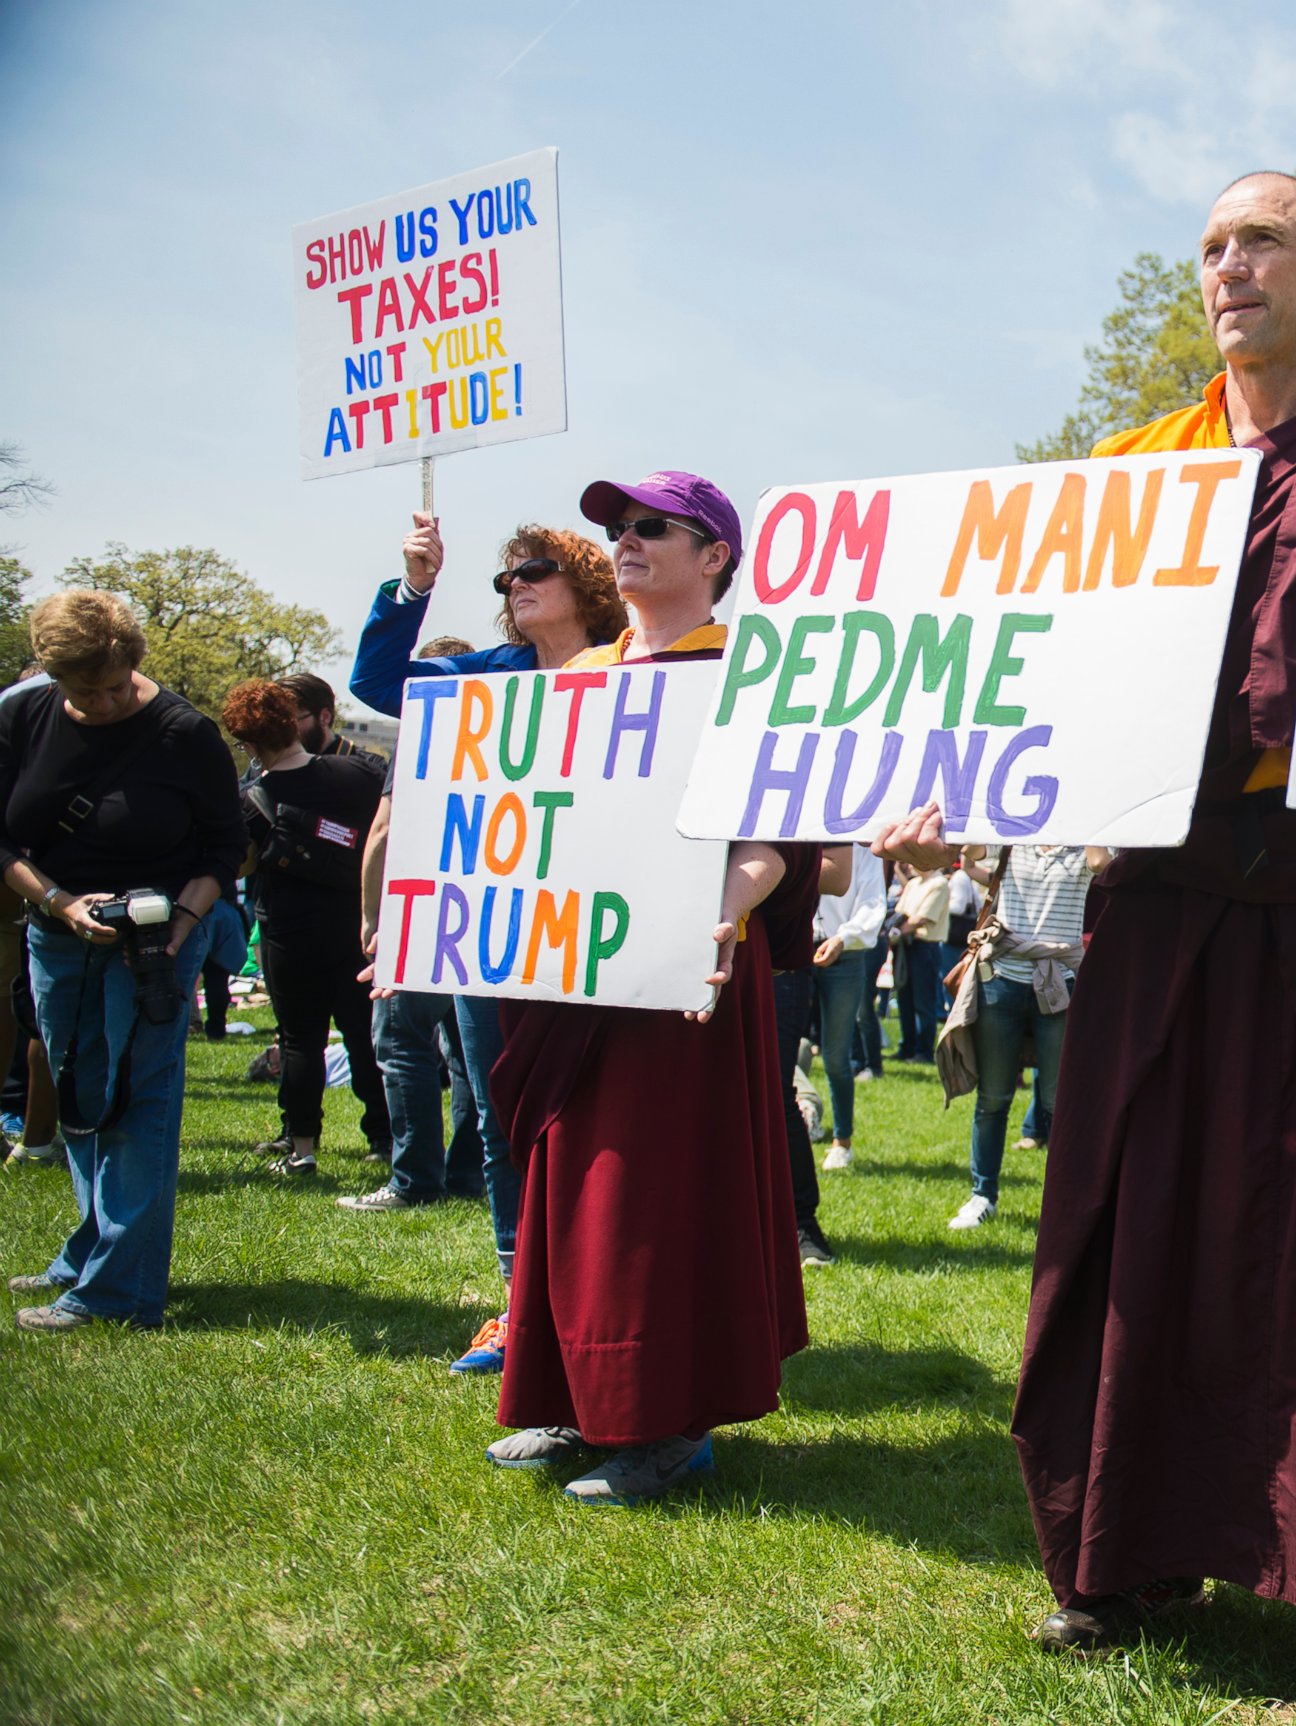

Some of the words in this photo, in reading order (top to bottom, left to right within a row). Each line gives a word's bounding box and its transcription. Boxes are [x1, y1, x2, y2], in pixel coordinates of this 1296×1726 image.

[306, 219, 386, 290] SHOW
[395, 206, 438, 263] US
[448, 178, 537, 245] YOUR
[337, 248, 499, 345] TAXES!
[323, 363, 522, 457] ATTITUDE!
[345, 341, 406, 395] NOT
[422, 316, 508, 374] YOUR
[753, 489, 891, 605] OM
[940, 460, 1242, 598] MANI
[714, 610, 1054, 729] PEDME
[407, 670, 666, 782] TRUTH
[737, 725, 1059, 837] HUNG
[439, 791, 574, 879] NOT
[388, 878, 630, 997] TRUMP
